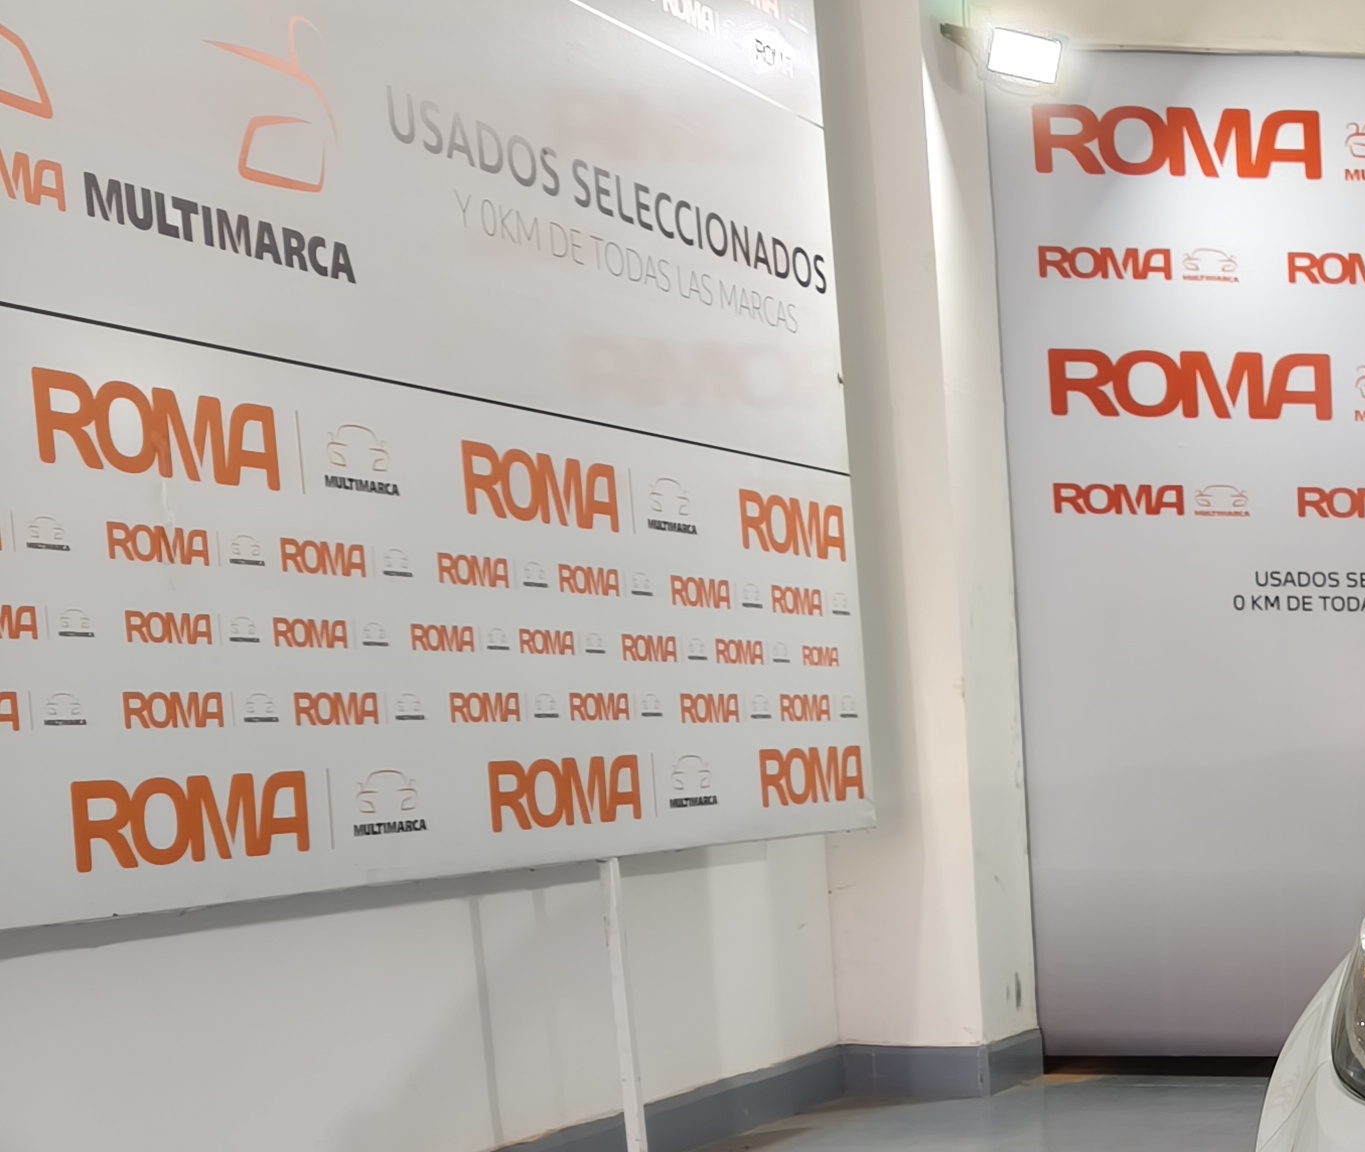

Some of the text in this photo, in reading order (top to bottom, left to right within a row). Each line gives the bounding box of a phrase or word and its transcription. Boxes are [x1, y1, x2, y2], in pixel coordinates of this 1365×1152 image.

[1033, 104, 1322, 180] ROMA
[386, 85, 827, 294] USADOS SELECCIONADOS
[83, 171, 357, 284] MULTIMARCA
[453, 188, 471, 228] Y
[549, 220, 585, 266] DE
[588, 233, 671, 292] TODAS
[677, 265, 713, 306] LAS
[719, 280, 798, 334] MARCAS
[1038, 246, 1173, 280] ROMA
[1048, 348, 1333, 421] ROMA
[32, 366, 281, 491] ROMA
[325, 475, 400, 496] MULTIMARCA
[461, 439, 620, 533] ROMA
[1053, 483, 1185, 516] ROMA
[739, 488, 847, 562] ROMA
[106, 521, 210, 566] ROMA
[280, 537, 366, 578] ROMA
[438, 552, 510, 588] ROMA
[559, 564, 620, 597] ROMA
[1255, 571, 1339, 587] USADOS
[670, 575, 731, 609] ROMA
[772, 585, 823, 616] ROMA
[1233, 595, 1245, 611] 0
[1252, 595, 1280, 610] KM
[1287, 596, 1312, 611] DE
[125, 610, 213, 645] ROMA
[274, 617, 348, 649] ROMA
[411, 624, 475, 652] ROMA
[520, 629, 575, 656] ROMA
[622, 634, 677, 662] ROMA
[716, 639, 764, 665] ROMA
[803, 646, 840, 667] ROMA
[123, 692, 224, 729] ROMA
[294, 692, 379, 726] ROMA
[450, 692, 520, 723] ROMA
[570, 693, 630, 721] ROMA
[680, 693, 739, 724] ROMA
[780, 694, 831, 722] ROMA
[488, 755, 642, 833] ROMA
[759, 746, 864, 808] ROMA
[70, 771, 310, 873] ROMA
[354, 819, 426, 836] MULTIMARCA
